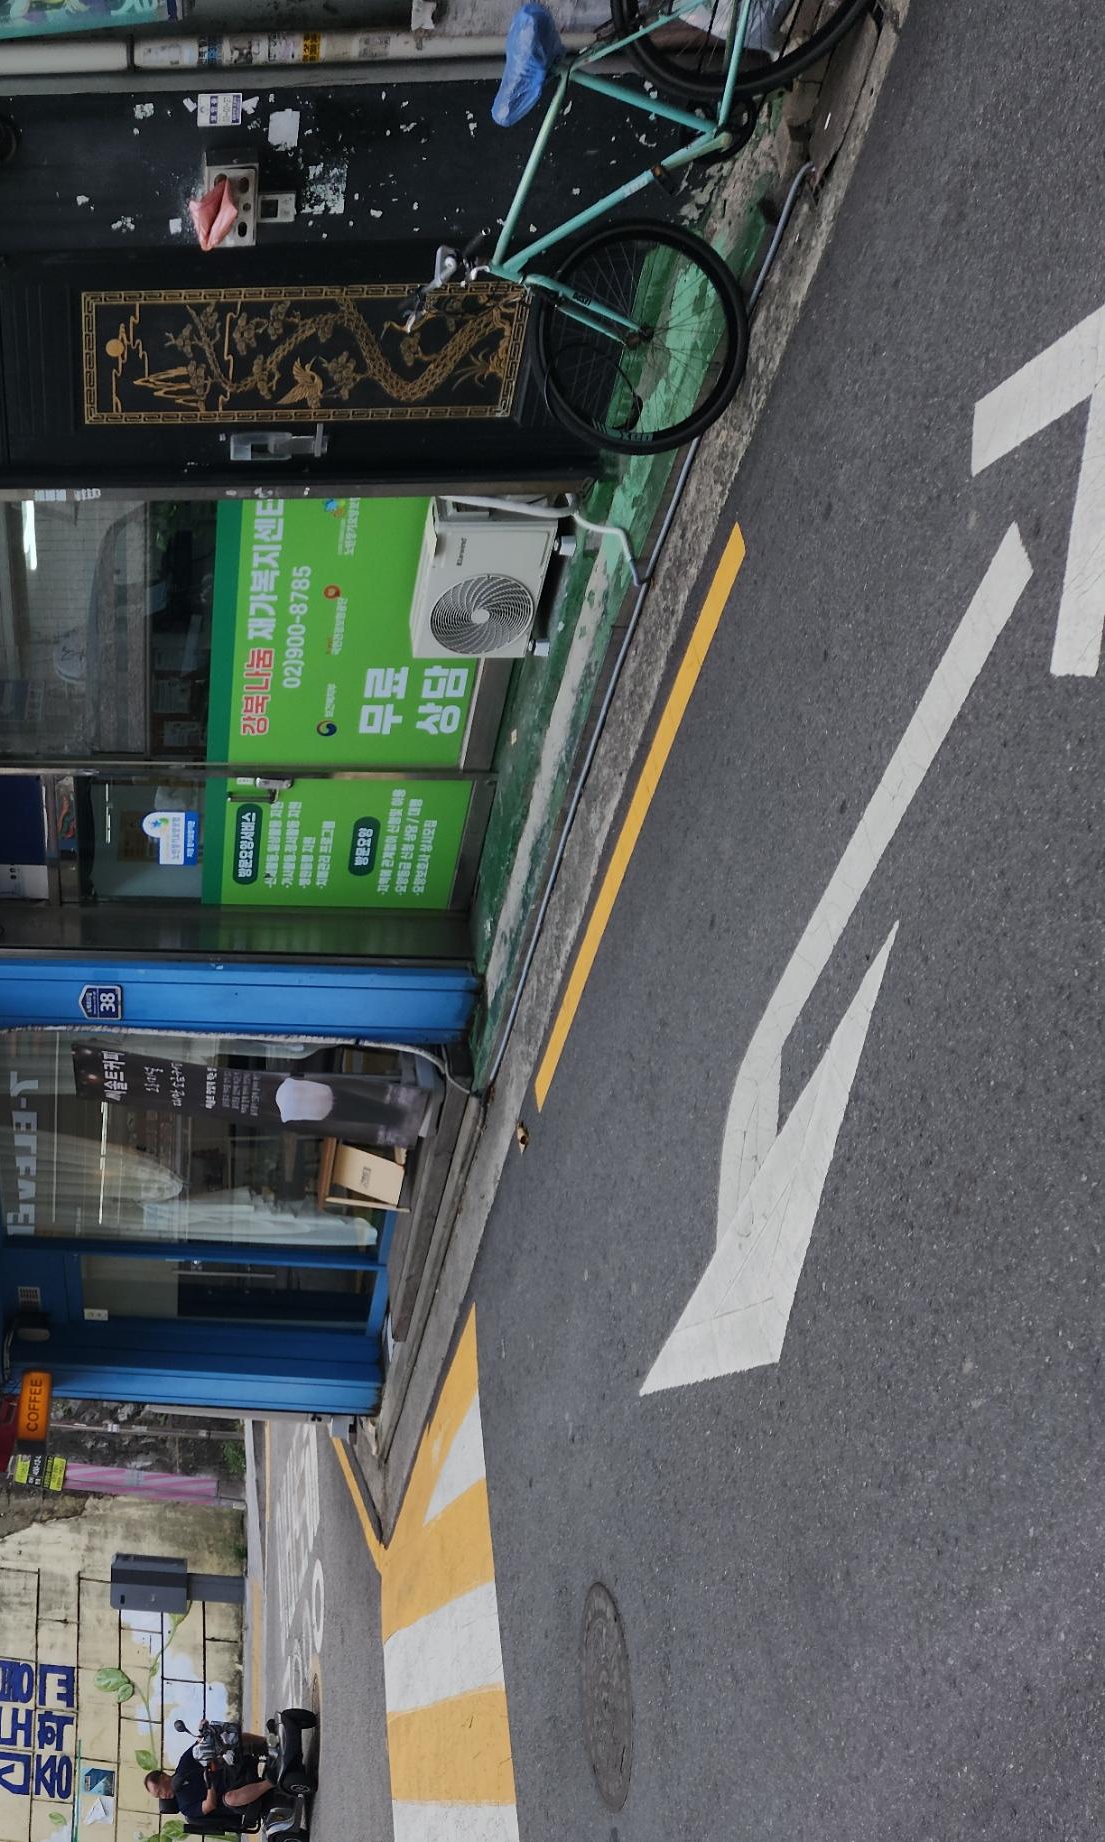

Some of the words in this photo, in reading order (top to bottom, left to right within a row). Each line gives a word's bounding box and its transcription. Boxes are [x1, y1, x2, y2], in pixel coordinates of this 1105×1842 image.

[281, 565, 313, 689] 02)900-8785
[240, 647, 275, 736] 강북나눔
[358, 666, 410, 735] 무료
[415, 665, 469, 735] 상담
[238, 812, 256, 878] 방문요양서비스
[354, 827, 374, 866] 방문요양
[100, 992, 116, 1012] 38
[102, 1051, 127, 1101] 씨솔트커피
[26, 1379, 43, 1432] COFFEE
[34, 1663, 75, 1799] 중학교
